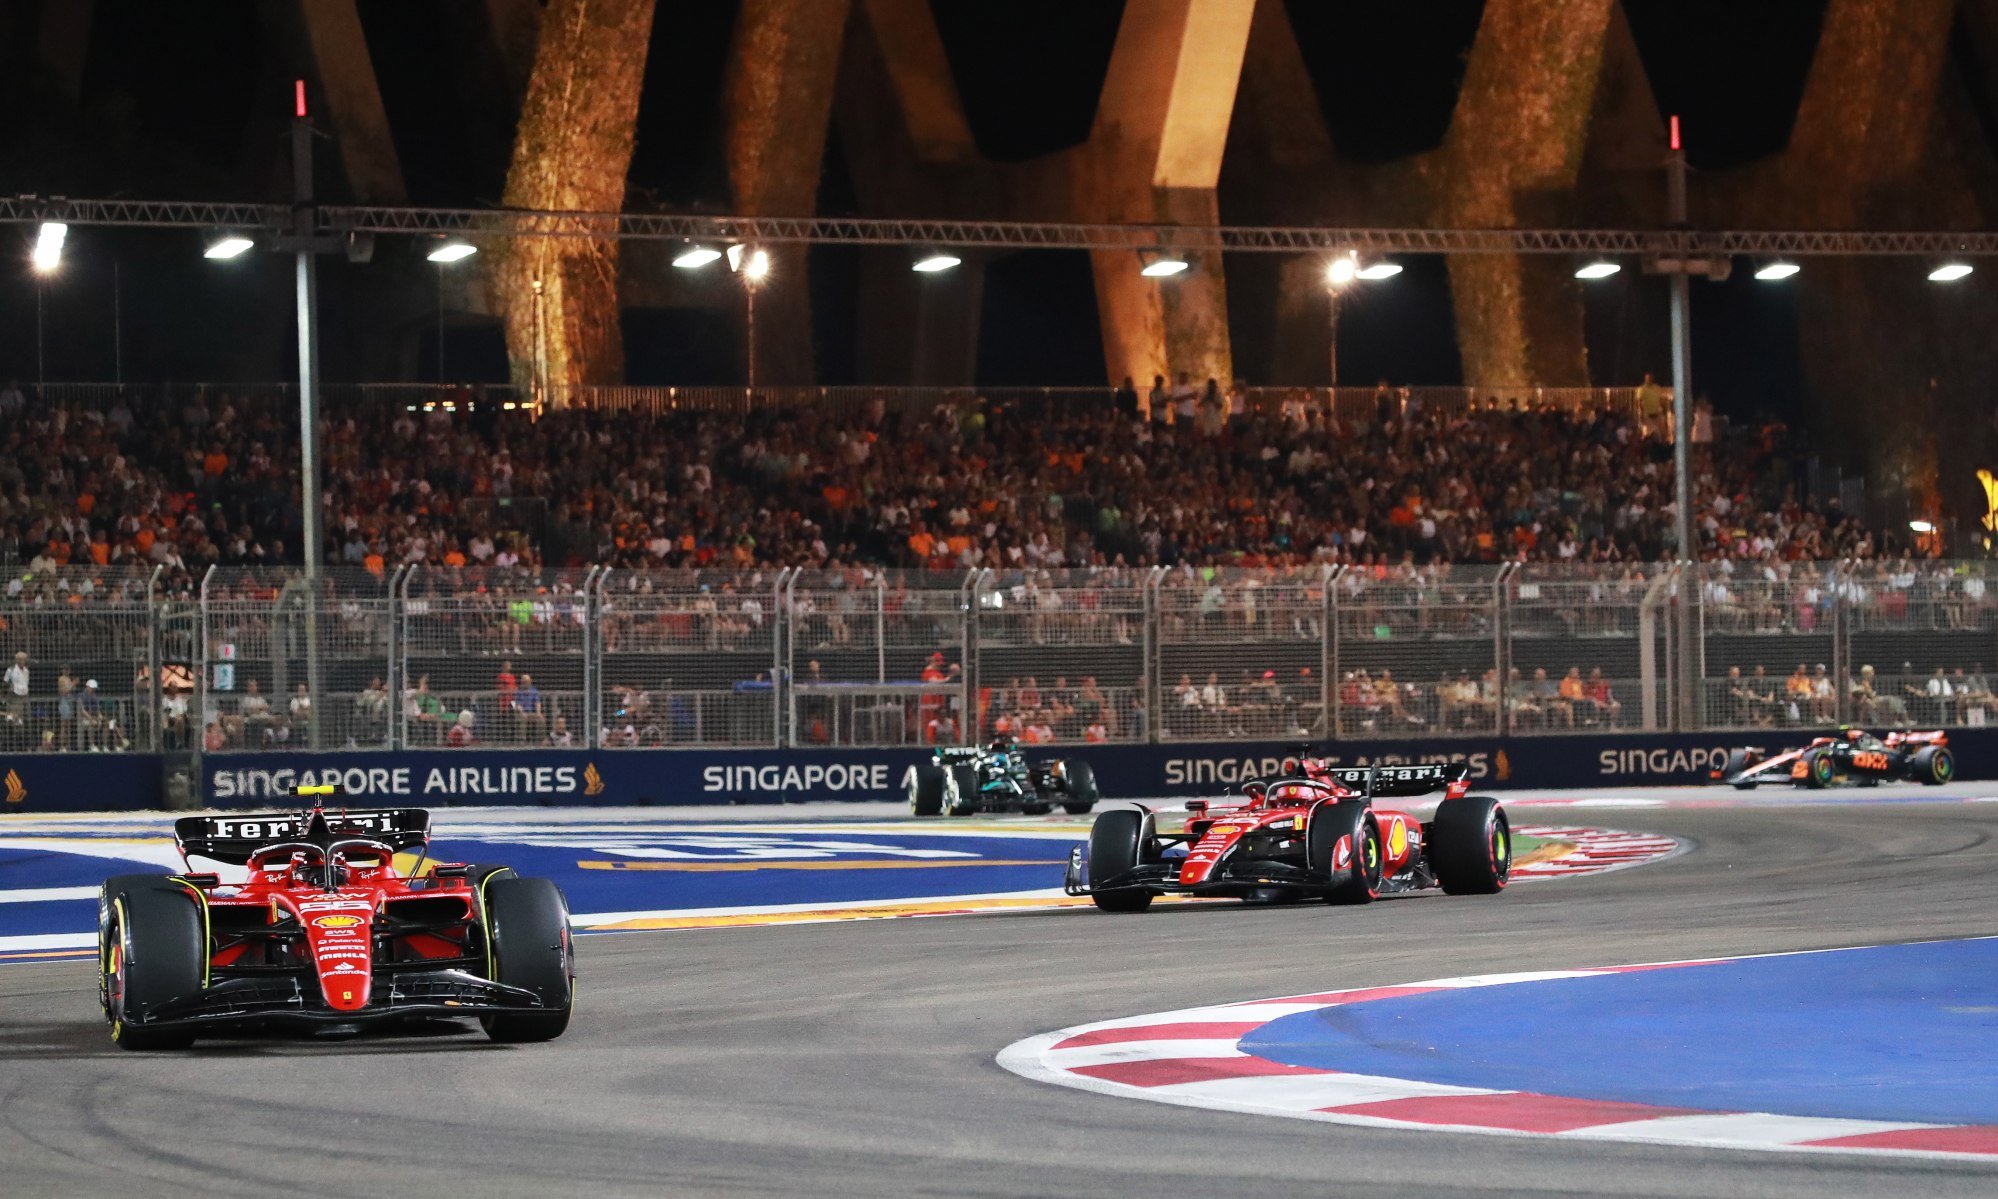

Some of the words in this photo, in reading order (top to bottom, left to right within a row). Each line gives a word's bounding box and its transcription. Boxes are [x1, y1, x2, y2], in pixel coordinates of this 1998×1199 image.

[424, 767, 576, 794] AIRLINES
[704, 763, 888, 791] SINGAPORE
[299, 901, 372, 914] 55
